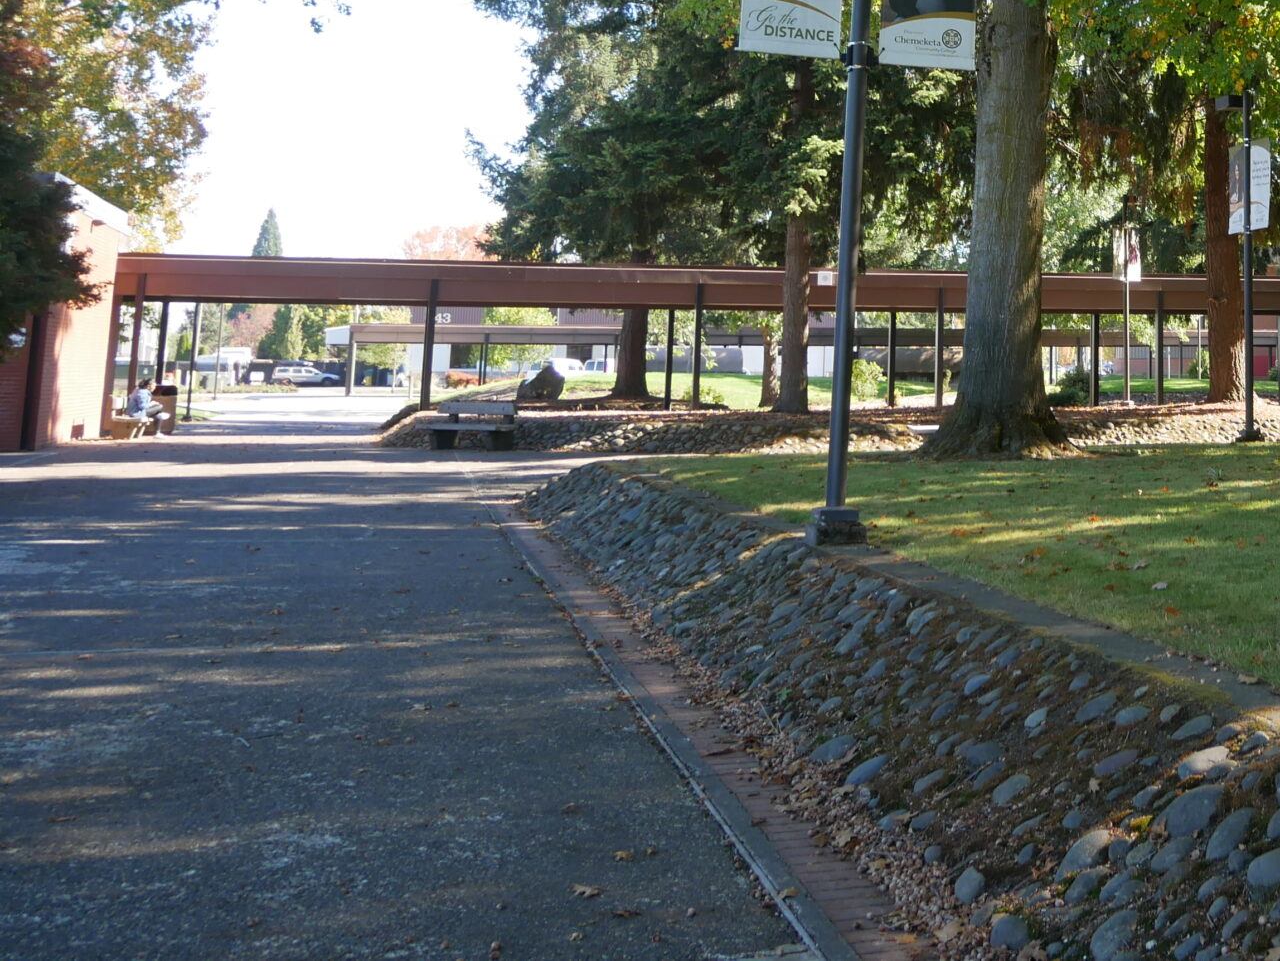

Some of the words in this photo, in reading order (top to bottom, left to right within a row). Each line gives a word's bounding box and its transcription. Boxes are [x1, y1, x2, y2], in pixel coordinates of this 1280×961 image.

[746, 5, 776, 31] Go
[778, 6, 798, 26] the
[764, 24, 834, 42] DISTANCE
[894, 35, 941, 47] Chemeketa
